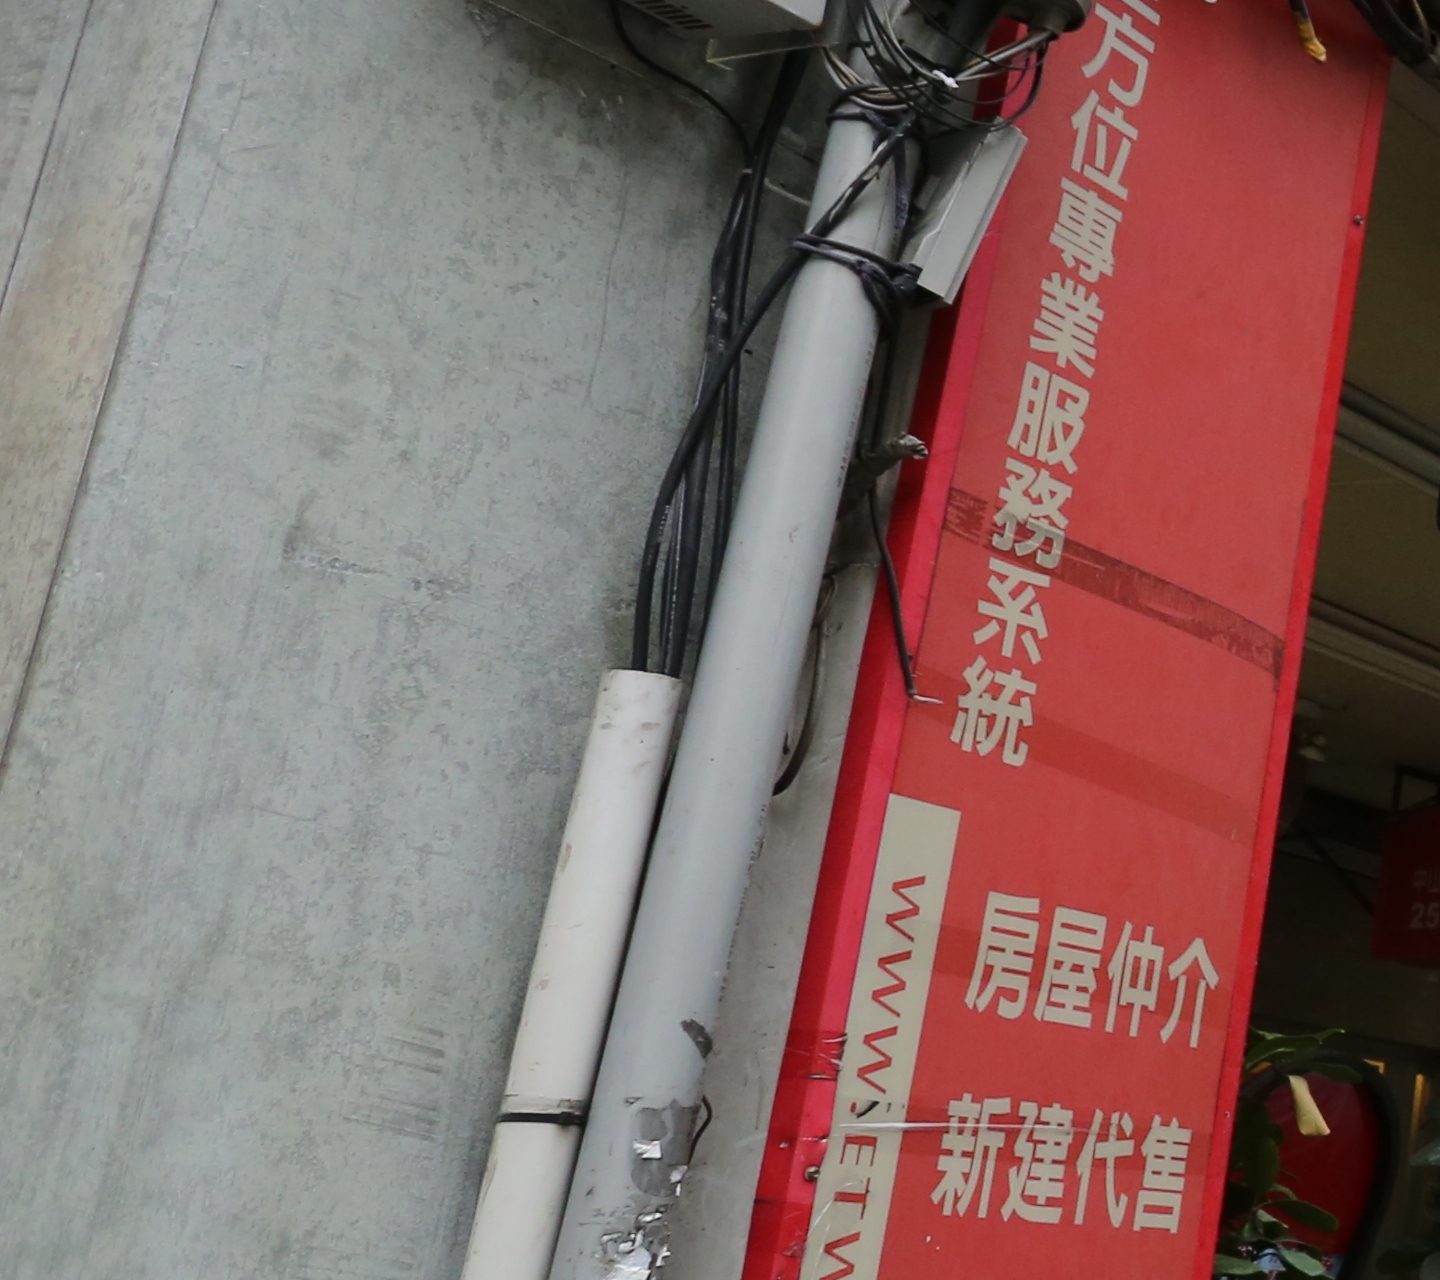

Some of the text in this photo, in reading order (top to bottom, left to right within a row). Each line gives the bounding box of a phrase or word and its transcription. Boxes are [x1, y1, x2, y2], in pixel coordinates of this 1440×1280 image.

[964, 889, 1219, 1051] 房屋仲介
[930, 1095, 1194, 1235] 新建代售
